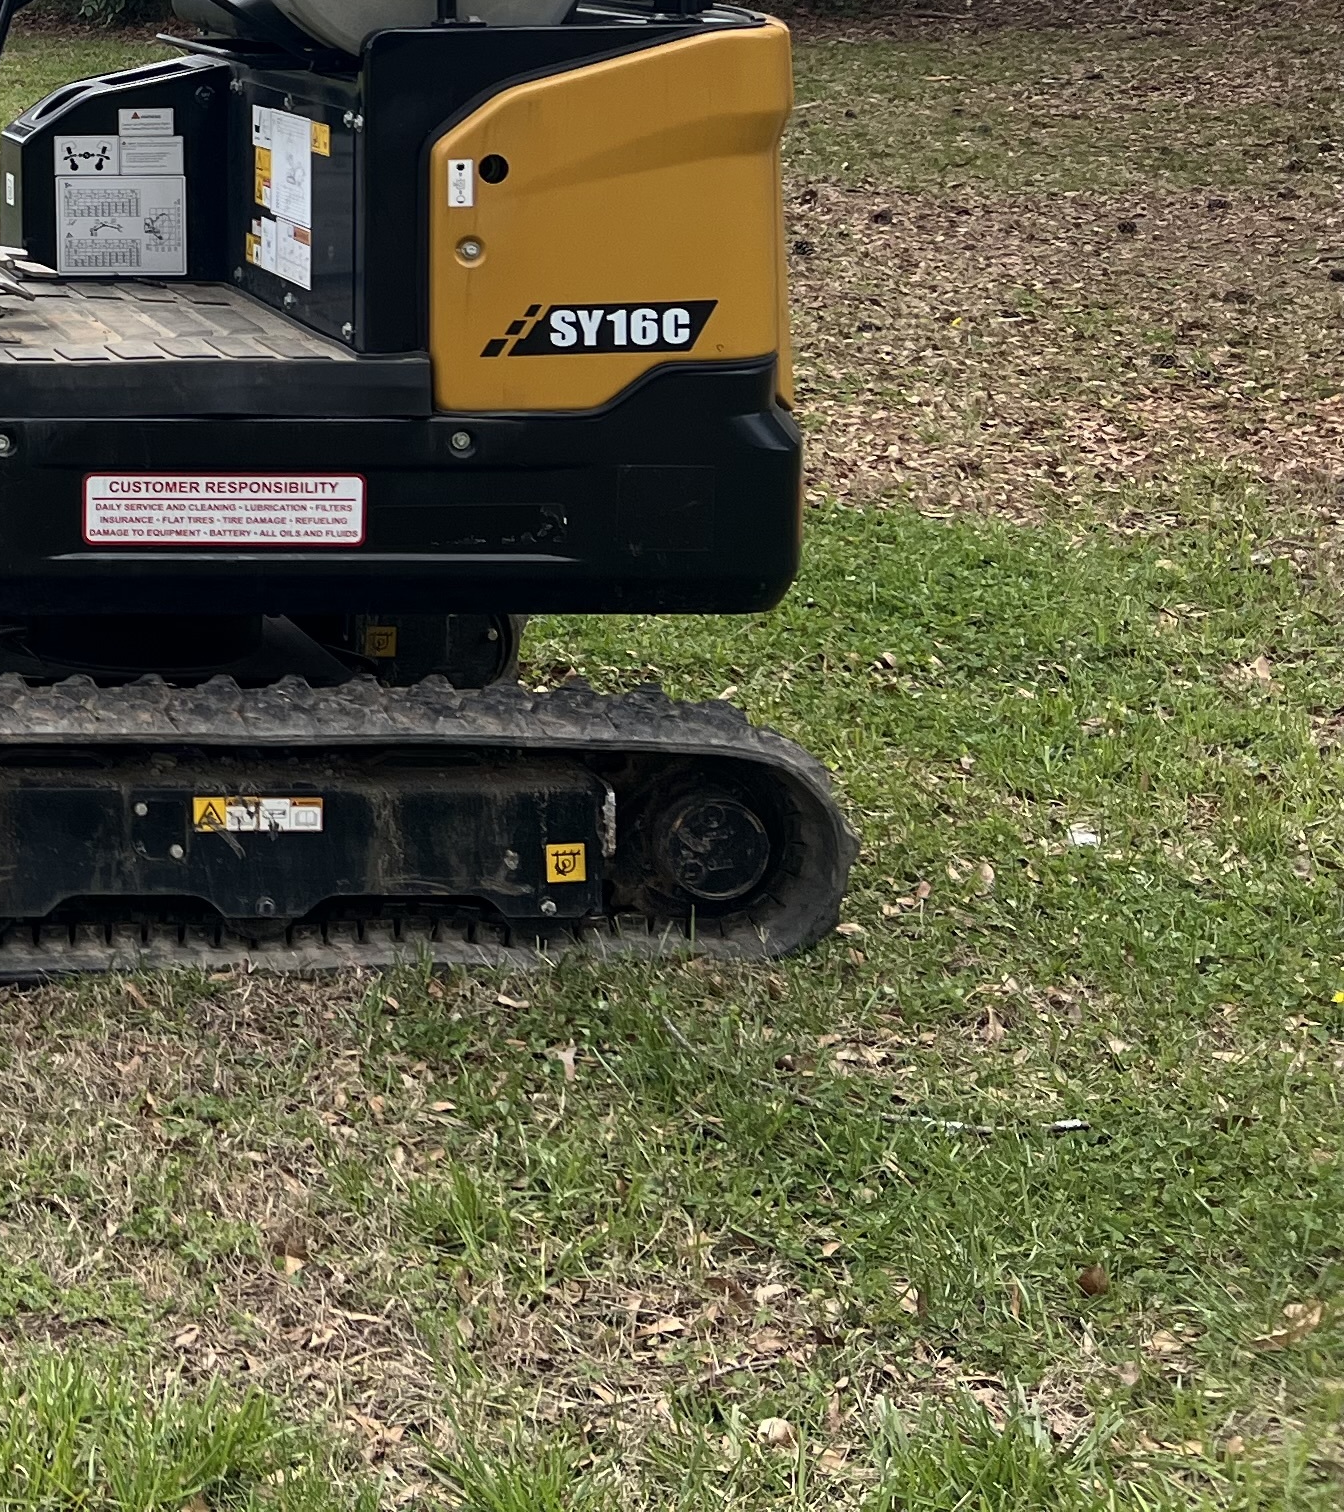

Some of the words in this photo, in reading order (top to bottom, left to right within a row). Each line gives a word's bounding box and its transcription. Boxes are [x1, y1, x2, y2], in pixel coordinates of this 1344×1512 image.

[549, 307, 691, 347] SY16C
[109, 481, 200, 493] CUSTOMER
[205, 481, 339, 494] RESPONSIBILITY
[95, 503, 122, 511] DAILY
[124, 503, 164, 511] SERVICE
[166, 503, 186, 511] AND
[188, 503, 236, 511] CLEANING
[244, 504, 307, 512] LUBRICATION
[315, 504, 353, 512] FILTERS
[100, 516, 154, 524] INSURANCE
[162, 516, 185, 524] FLAT
[187, 516, 214, 524] TIRES
[223, 516, 243, 524] TIRE
[246, 517, 287, 525] DAMAGE
[295, 517, 348, 525] REFUELING
[89, 529, 129, 537] DAMAGE
[132, 529, 145, 537] TO
[147, 529, 201, 537] EQUIPMENT
[209, 529, 251, 537] BATTERY
[259, 529, 277, 537] ALL
[279, 529, 301, 538] OILS
[303, 529, 323, 538] AND
[325, 529, 359, 538] FLUIDS
